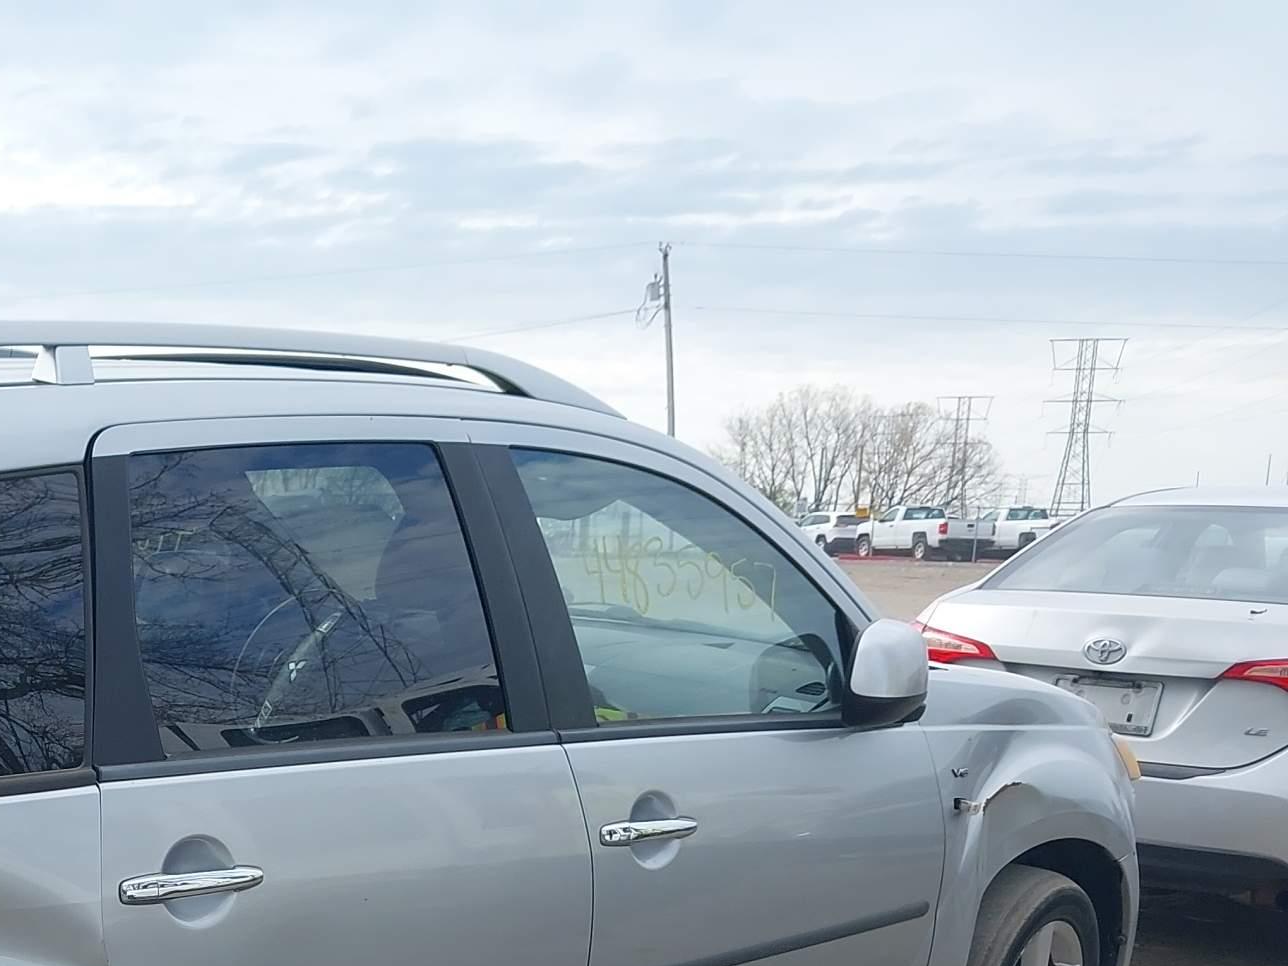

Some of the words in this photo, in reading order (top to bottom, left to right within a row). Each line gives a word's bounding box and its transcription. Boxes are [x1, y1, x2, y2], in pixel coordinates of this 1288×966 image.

[584, 534, 777, 621] 44835957
[1243, 727, 1270, 737] LE
[951, 767, 969, 778] V6
